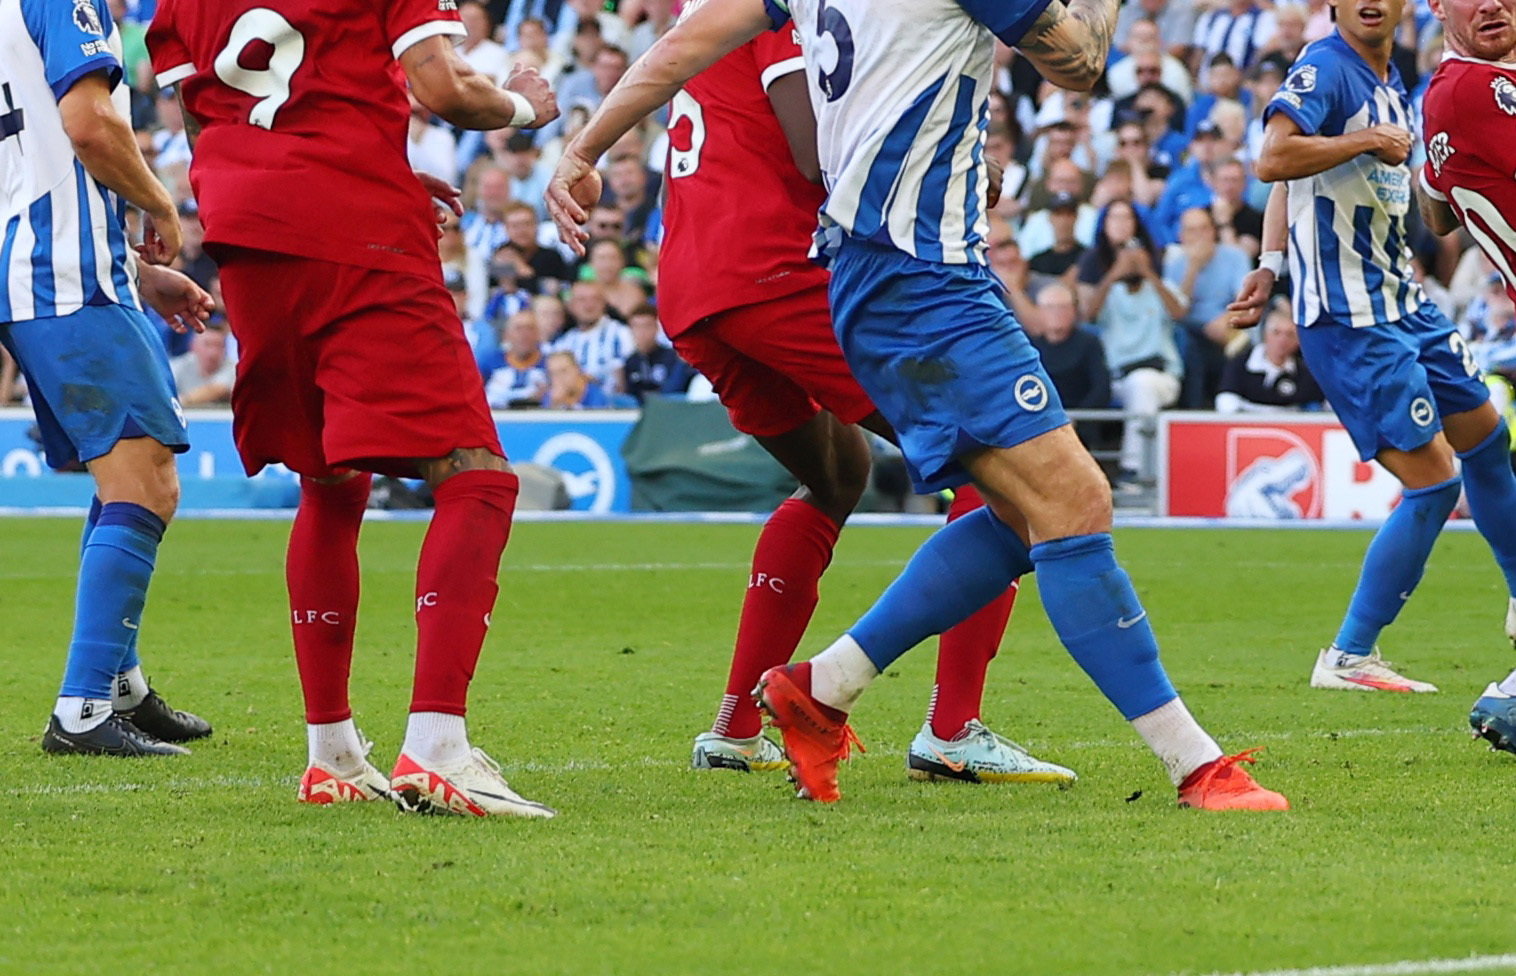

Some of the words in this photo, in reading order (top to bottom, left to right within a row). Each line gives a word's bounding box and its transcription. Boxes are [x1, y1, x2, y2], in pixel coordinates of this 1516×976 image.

[213, 7, 306, 131] 9
[748, 572, 785, 594] LFC
[293, 609, 340, 625] LFC
